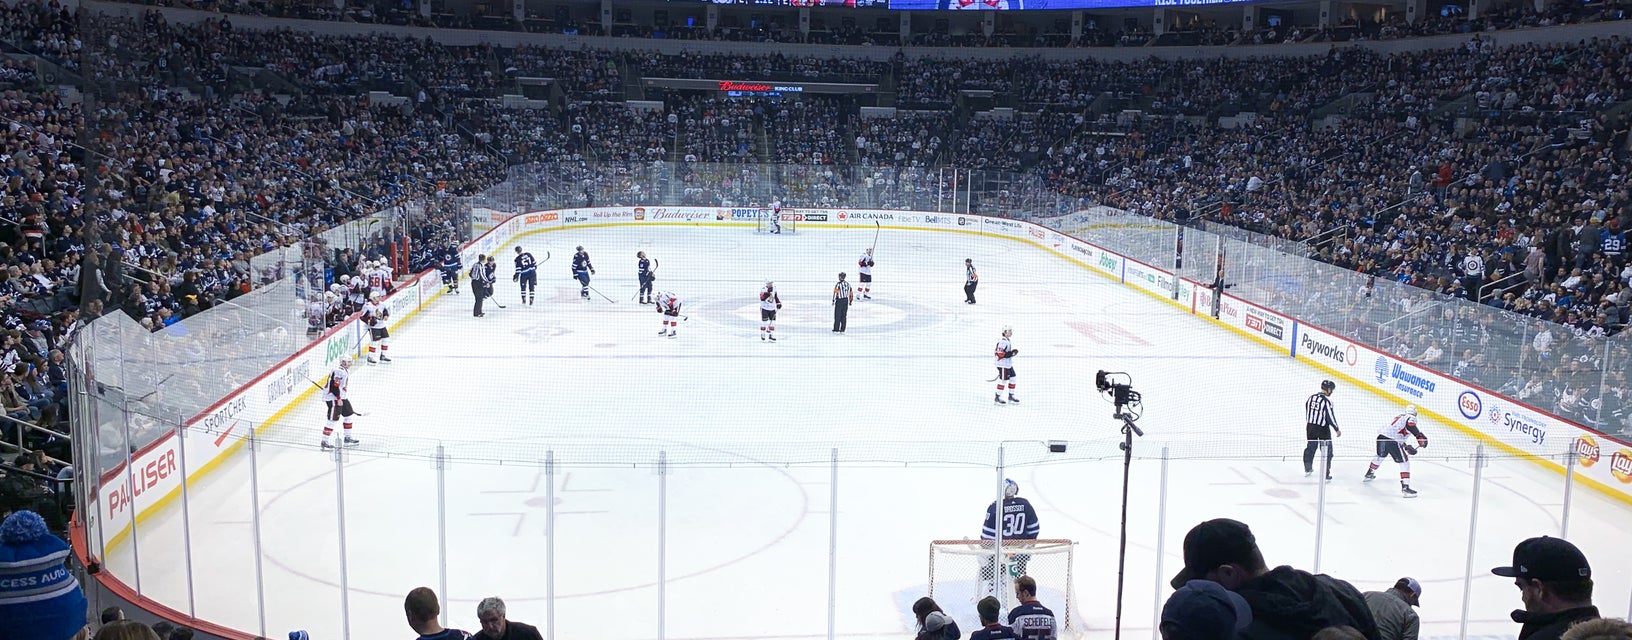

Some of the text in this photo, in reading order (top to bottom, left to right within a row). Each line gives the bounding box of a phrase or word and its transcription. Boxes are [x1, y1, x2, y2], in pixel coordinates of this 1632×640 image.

[719, 80, 772, 91] Budweiser
[653, 208, 710, 219] Budweiser
[1604, 239, 1620, 251] 29
[1301, 333, 1345, 363] Payworks
[1391, 362, 1436, 393] Wawanesa
[1396, 380, 1424, 399] Insurance
[1310, 401, 1320, 411] 93
[1503, 412, 1546, 445] Synergy
[108, 448, 177, 520] PALLISER
[1003, 512, 1026, 537] 30
[41, 569, 66, 584] AUTO
